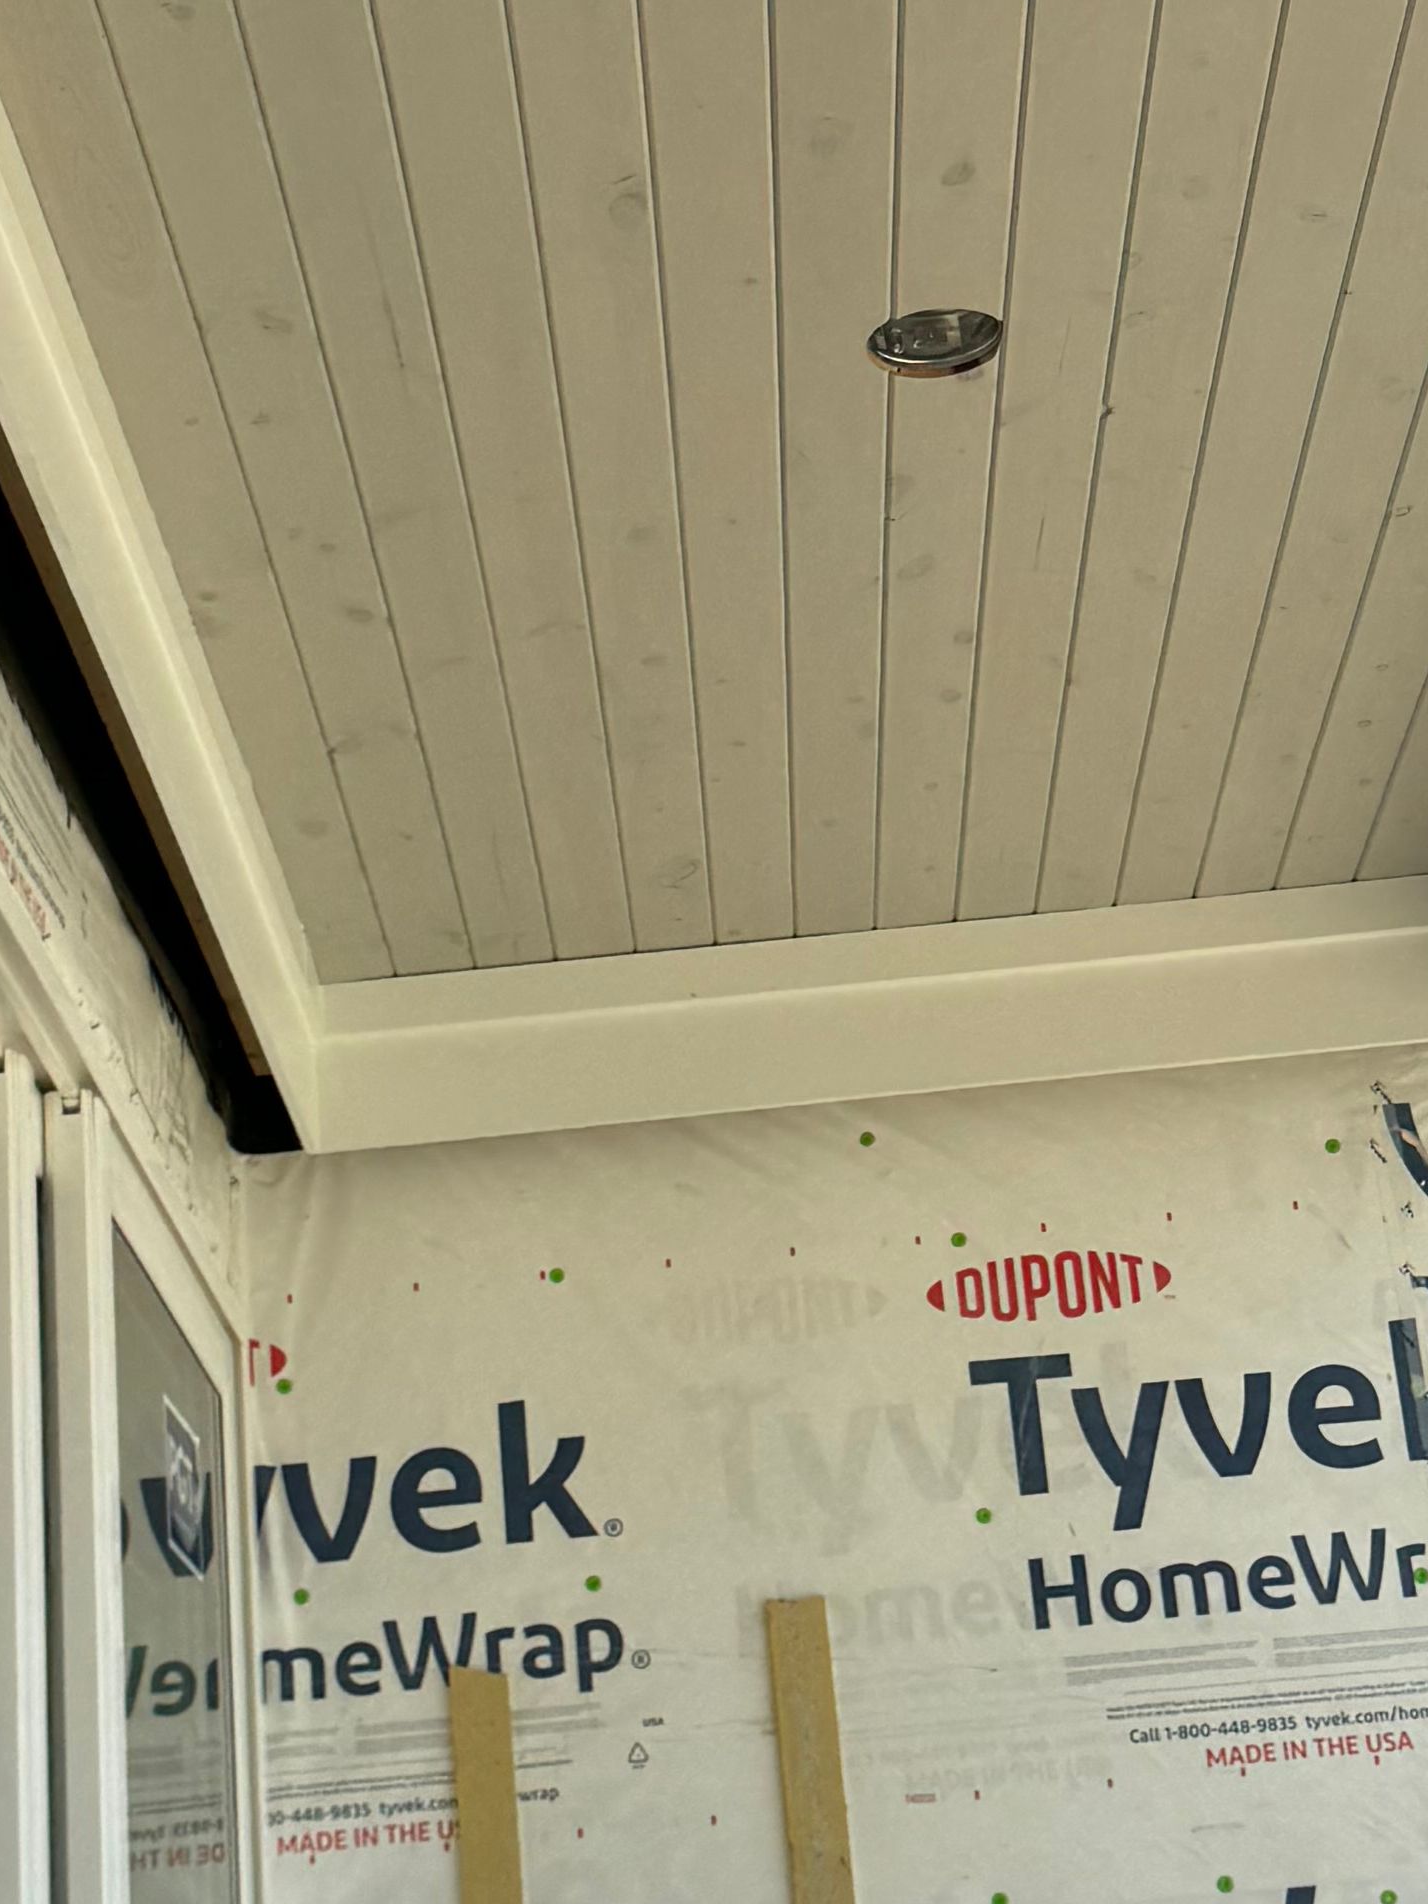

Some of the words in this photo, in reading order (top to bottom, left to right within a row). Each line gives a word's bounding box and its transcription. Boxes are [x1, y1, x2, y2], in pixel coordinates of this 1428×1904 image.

[956, 1250, 1144, 1322] DUPONT
[642, 1716, 665, 1727] USA
[1129, 1727, 1161, 1743] Call
[1165, 1717, 1298, 1741] 1-800-448-9835
[1206, 1743, 1277, 1767] MADE
[1283, 1740, 1308, 1761] IN
[1313, 1735, 1359, 1757] THE
[1365, 1731, 1414, 1754] USA
[277, 1826, 347, 1855] MADE
[353, 1824, 380, 1847] IN
[384, 1822, 432, 1844] THE
